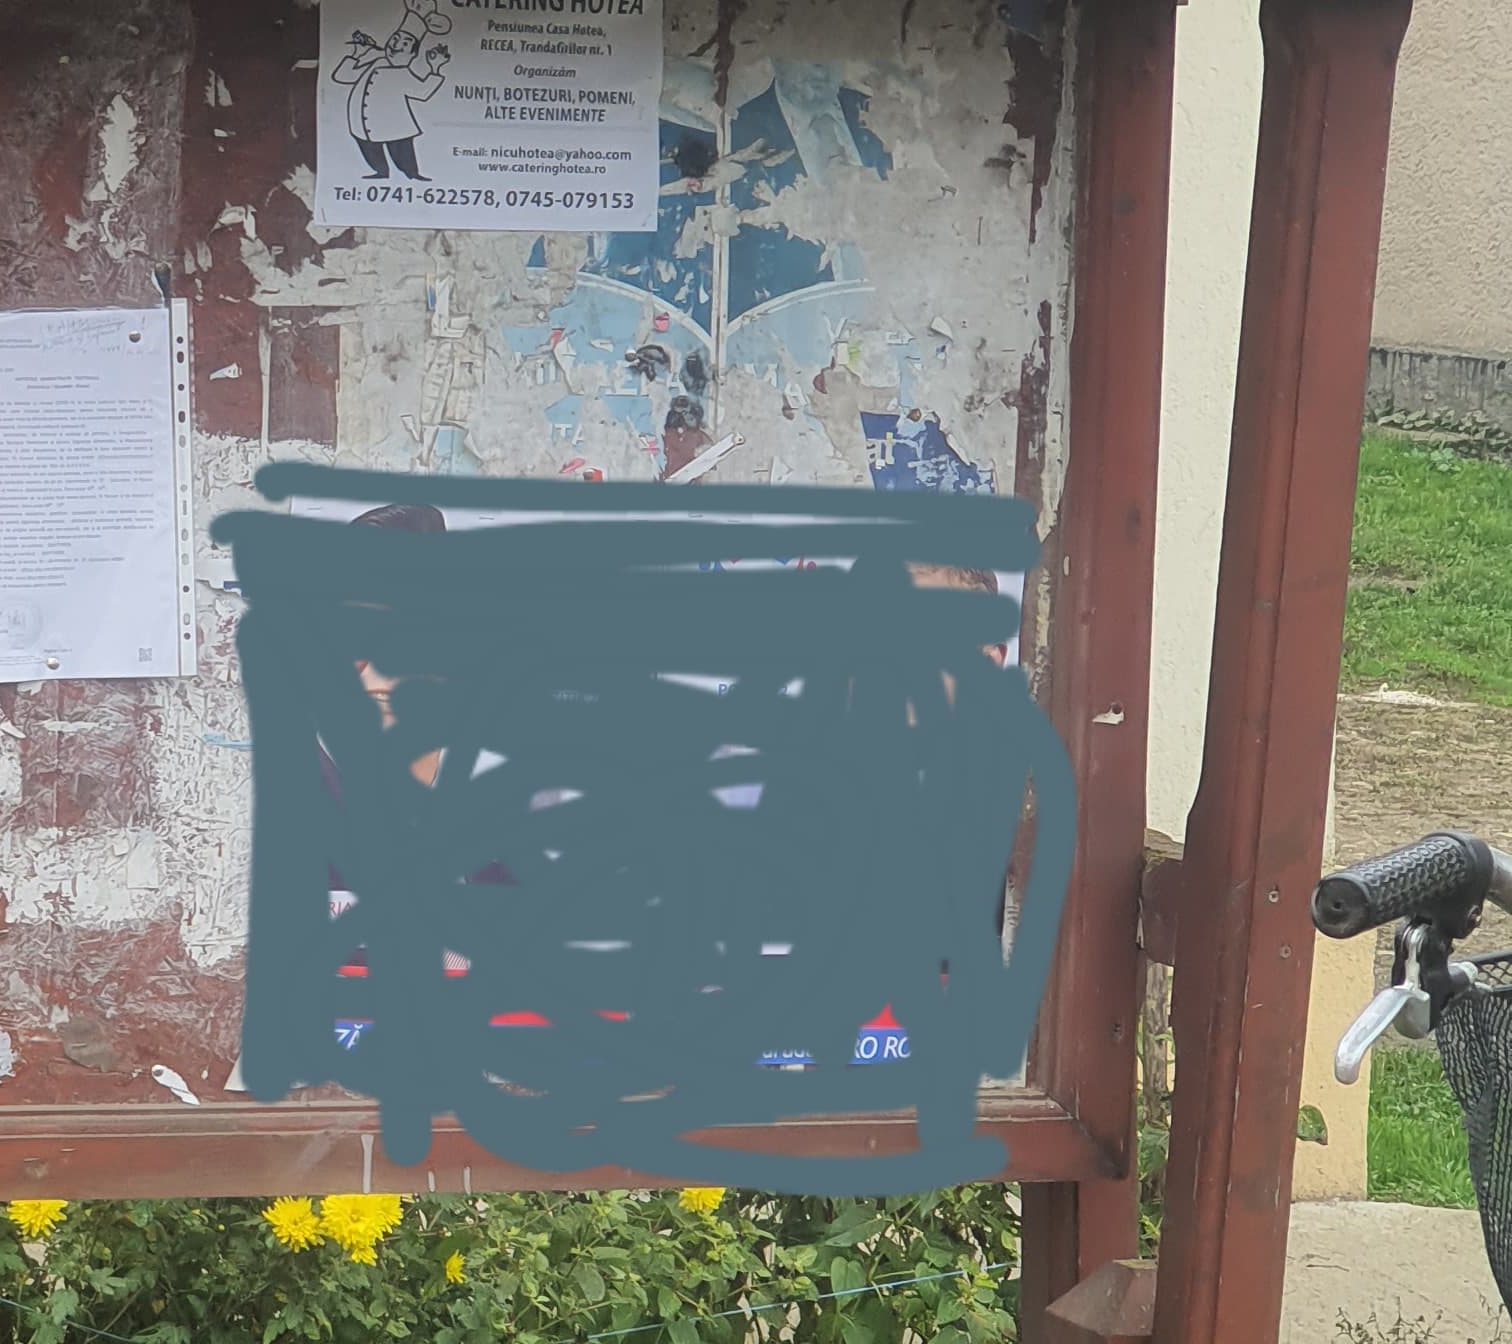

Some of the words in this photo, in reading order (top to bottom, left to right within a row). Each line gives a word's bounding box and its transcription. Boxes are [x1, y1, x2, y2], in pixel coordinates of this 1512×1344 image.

[488, 19, 544, 34] Pensiunea
[546, 23, 569, 35] Casa
[572, 24, 607, 38] Hotea,
[480, 39, 517, 53] RECEA,
[589, 47, 604, 55] nr.
[454, 86, 500, 104] NUNȚI,
[503, 88, 576, 104] BOTEZURI,
[579, 90, 636, 106] POMENI,
[484, 105, 516, 120] ALTE
[520, 107, 606, 122] EVENIMENTE
[452, 147, 488, 158] E-mail:
[491, 146, 632, 162] nicuhotea@yahoo.com
[478, 162, 607, 176] www.cateringhotea.ro
[334, 187, 362, 201] Tel:
[366, 186, 501, 208] 0741-622578,
[505, 190, 635, 209] 0745-079153
